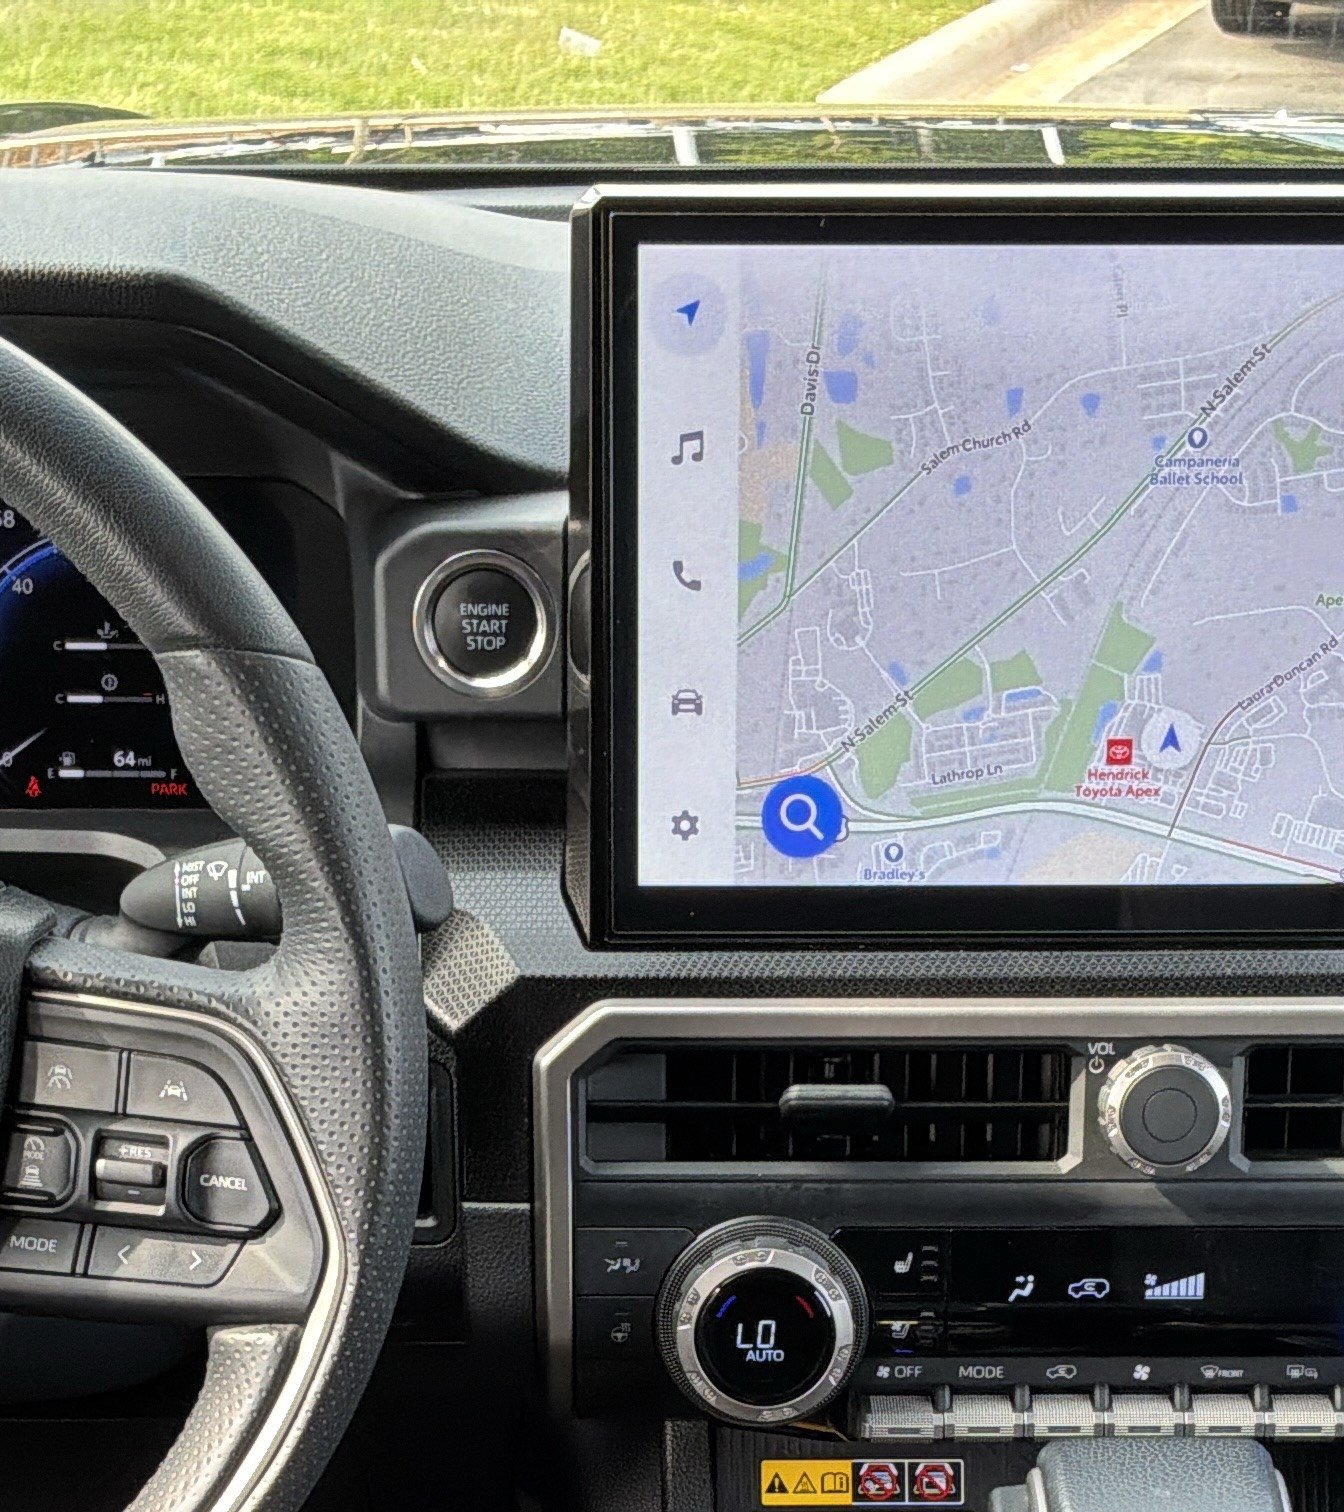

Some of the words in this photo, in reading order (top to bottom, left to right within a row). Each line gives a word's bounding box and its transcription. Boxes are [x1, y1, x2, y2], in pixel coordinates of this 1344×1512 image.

[806, 342, 821, 365] Dr
[1200, 399, 1217, 418] N
[1213, 357, 1256, 407] Salem
[1253, 343, 1272, 362] St
[800, 368, 820, 416] Davis
[920, 443, 960, 476] Salem
[961, 430, 1012, 453] Church
[1011, 418, 1032, 440] Rd
[1154, 455, 1241, 470] Campaneria
[1149, 472, 1191, 486] Ballet
[1193, 472, 1244, 486] School
[11, 577, 34, 596] 40
[459, 603, 510, 616] ENGINE
[461, 619, 509, 634] START
[466, 636, 507, 651] STOP
[1272, 652, 1322, 688] Duncan
[1319, 634, 1340, 655] Rd
[155, 693, 166, 706] H
[841, 735, 856, 753] N
[854, 703, 898, 742] Salem
[896, 690, 915, 708] St
[47, 768, 55, 780] E
[170, 768, 178, 780] F
[931, 765, 983, 786] Lathrop
[985, 762, 1003, 775] Ln
[1087, 768, 1149, 781] Hendrick
[151, 782, 188, 796] PARK
[1075, 785, 1123, 799] Toyota
[1125, 785, 1161, 799] Apex
[181, 873, 200, 886] OFF
[246, 870, 267, 884] INT
[181, 886, 198, 899] INT
[183, 915, 197, 927] HI
[1087, 1042, 1116, 1056] VOL
[23, 1150, 44, 1161] MODE
[199, 1173, 249, 1192] CANCEL
[9, 1235, 58, 1253] MODE
[736, 1319, 777, 1350] LO
[745, 1350, 785, 1363] AUTO
[894, 1365, 923, 1379] OFF
[959, 1365, 1005, 1379] MODE
[1218, 1369, 1244, 1379] FRONT
